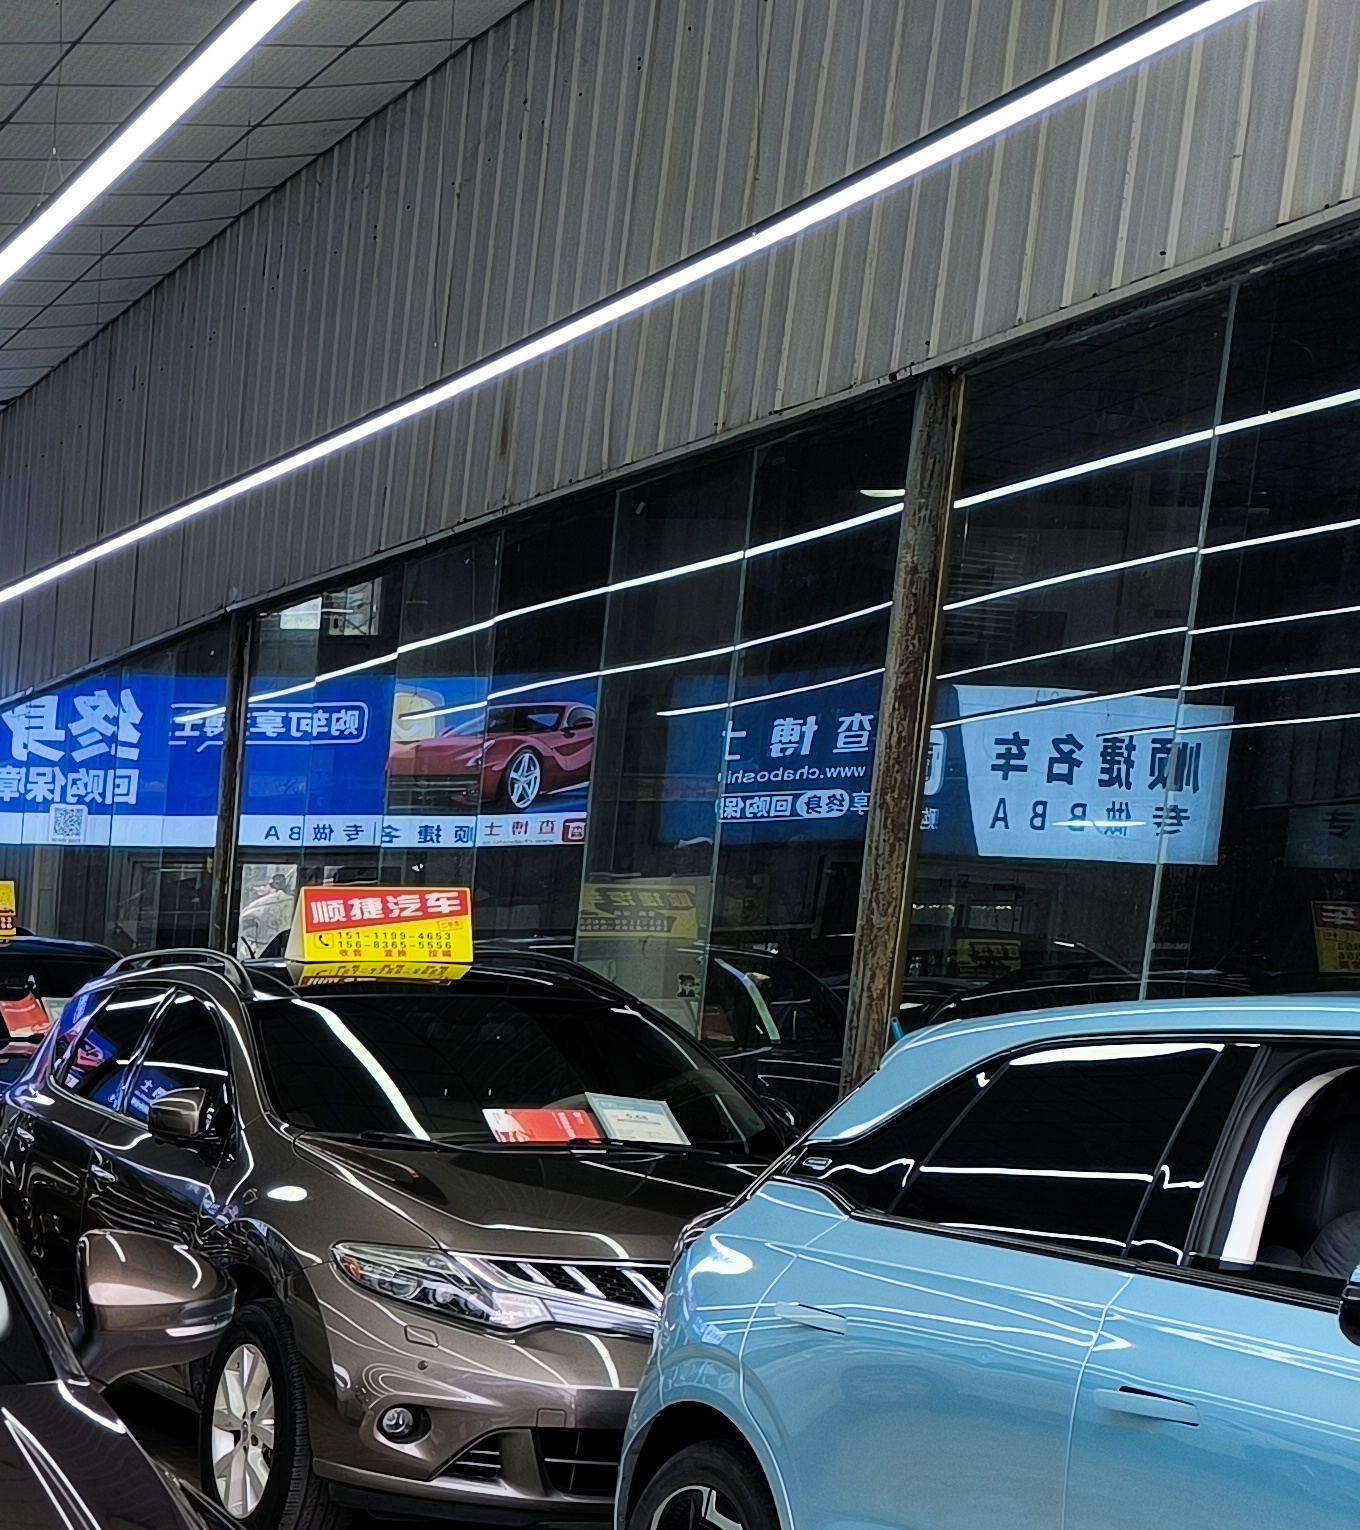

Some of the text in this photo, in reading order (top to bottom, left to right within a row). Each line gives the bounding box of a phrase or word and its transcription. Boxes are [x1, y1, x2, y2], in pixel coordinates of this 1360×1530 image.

[311, 891, 462, 924] 顺捷汽车
[338, 931, 452, 940] 151-1199-4653
[338, 941, 452, 949] 156-8365-5556
